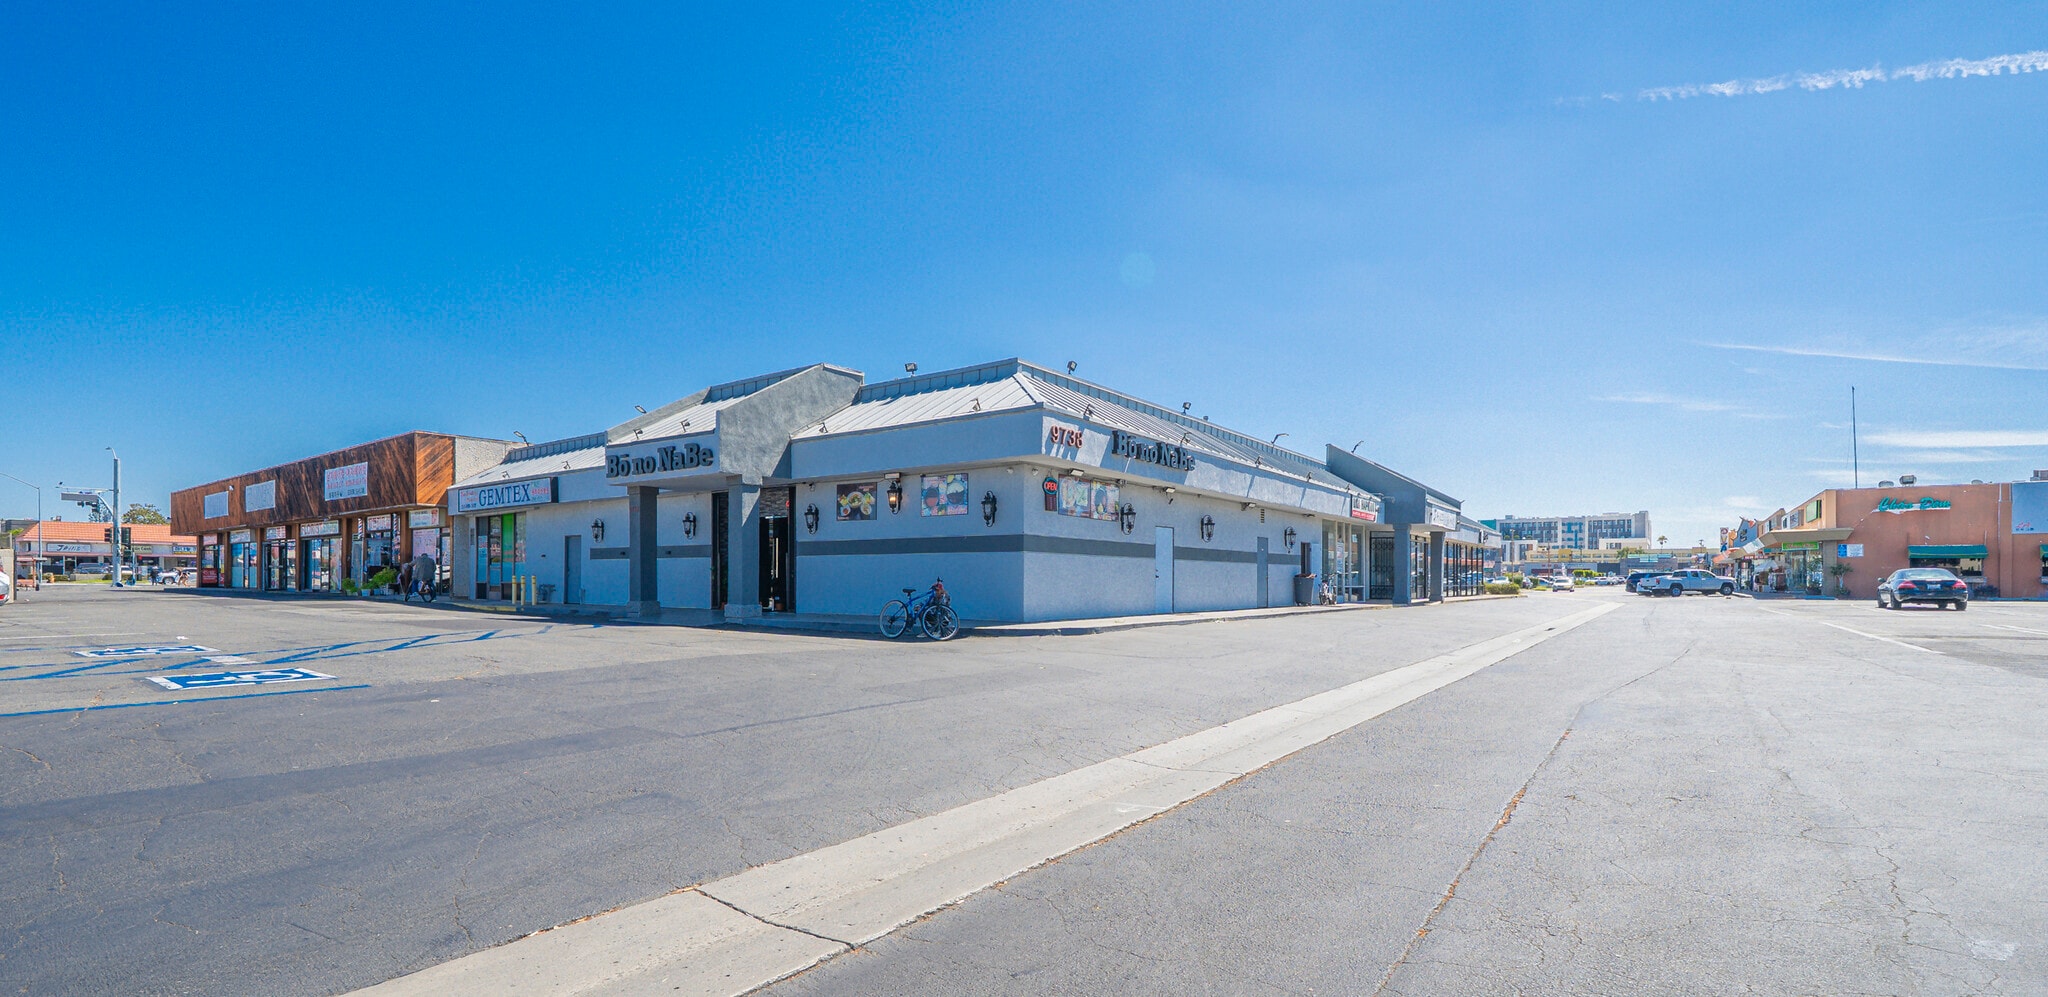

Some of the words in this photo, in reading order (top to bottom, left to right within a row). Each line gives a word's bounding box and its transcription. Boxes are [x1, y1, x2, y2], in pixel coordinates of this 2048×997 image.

[1050, 425, 1083, 449] 9738
[657, 443, 714, 472] NaBe
[479, 484, 531, 507] GEMTEX
[1044, 481, 1058, 491] OPEN
